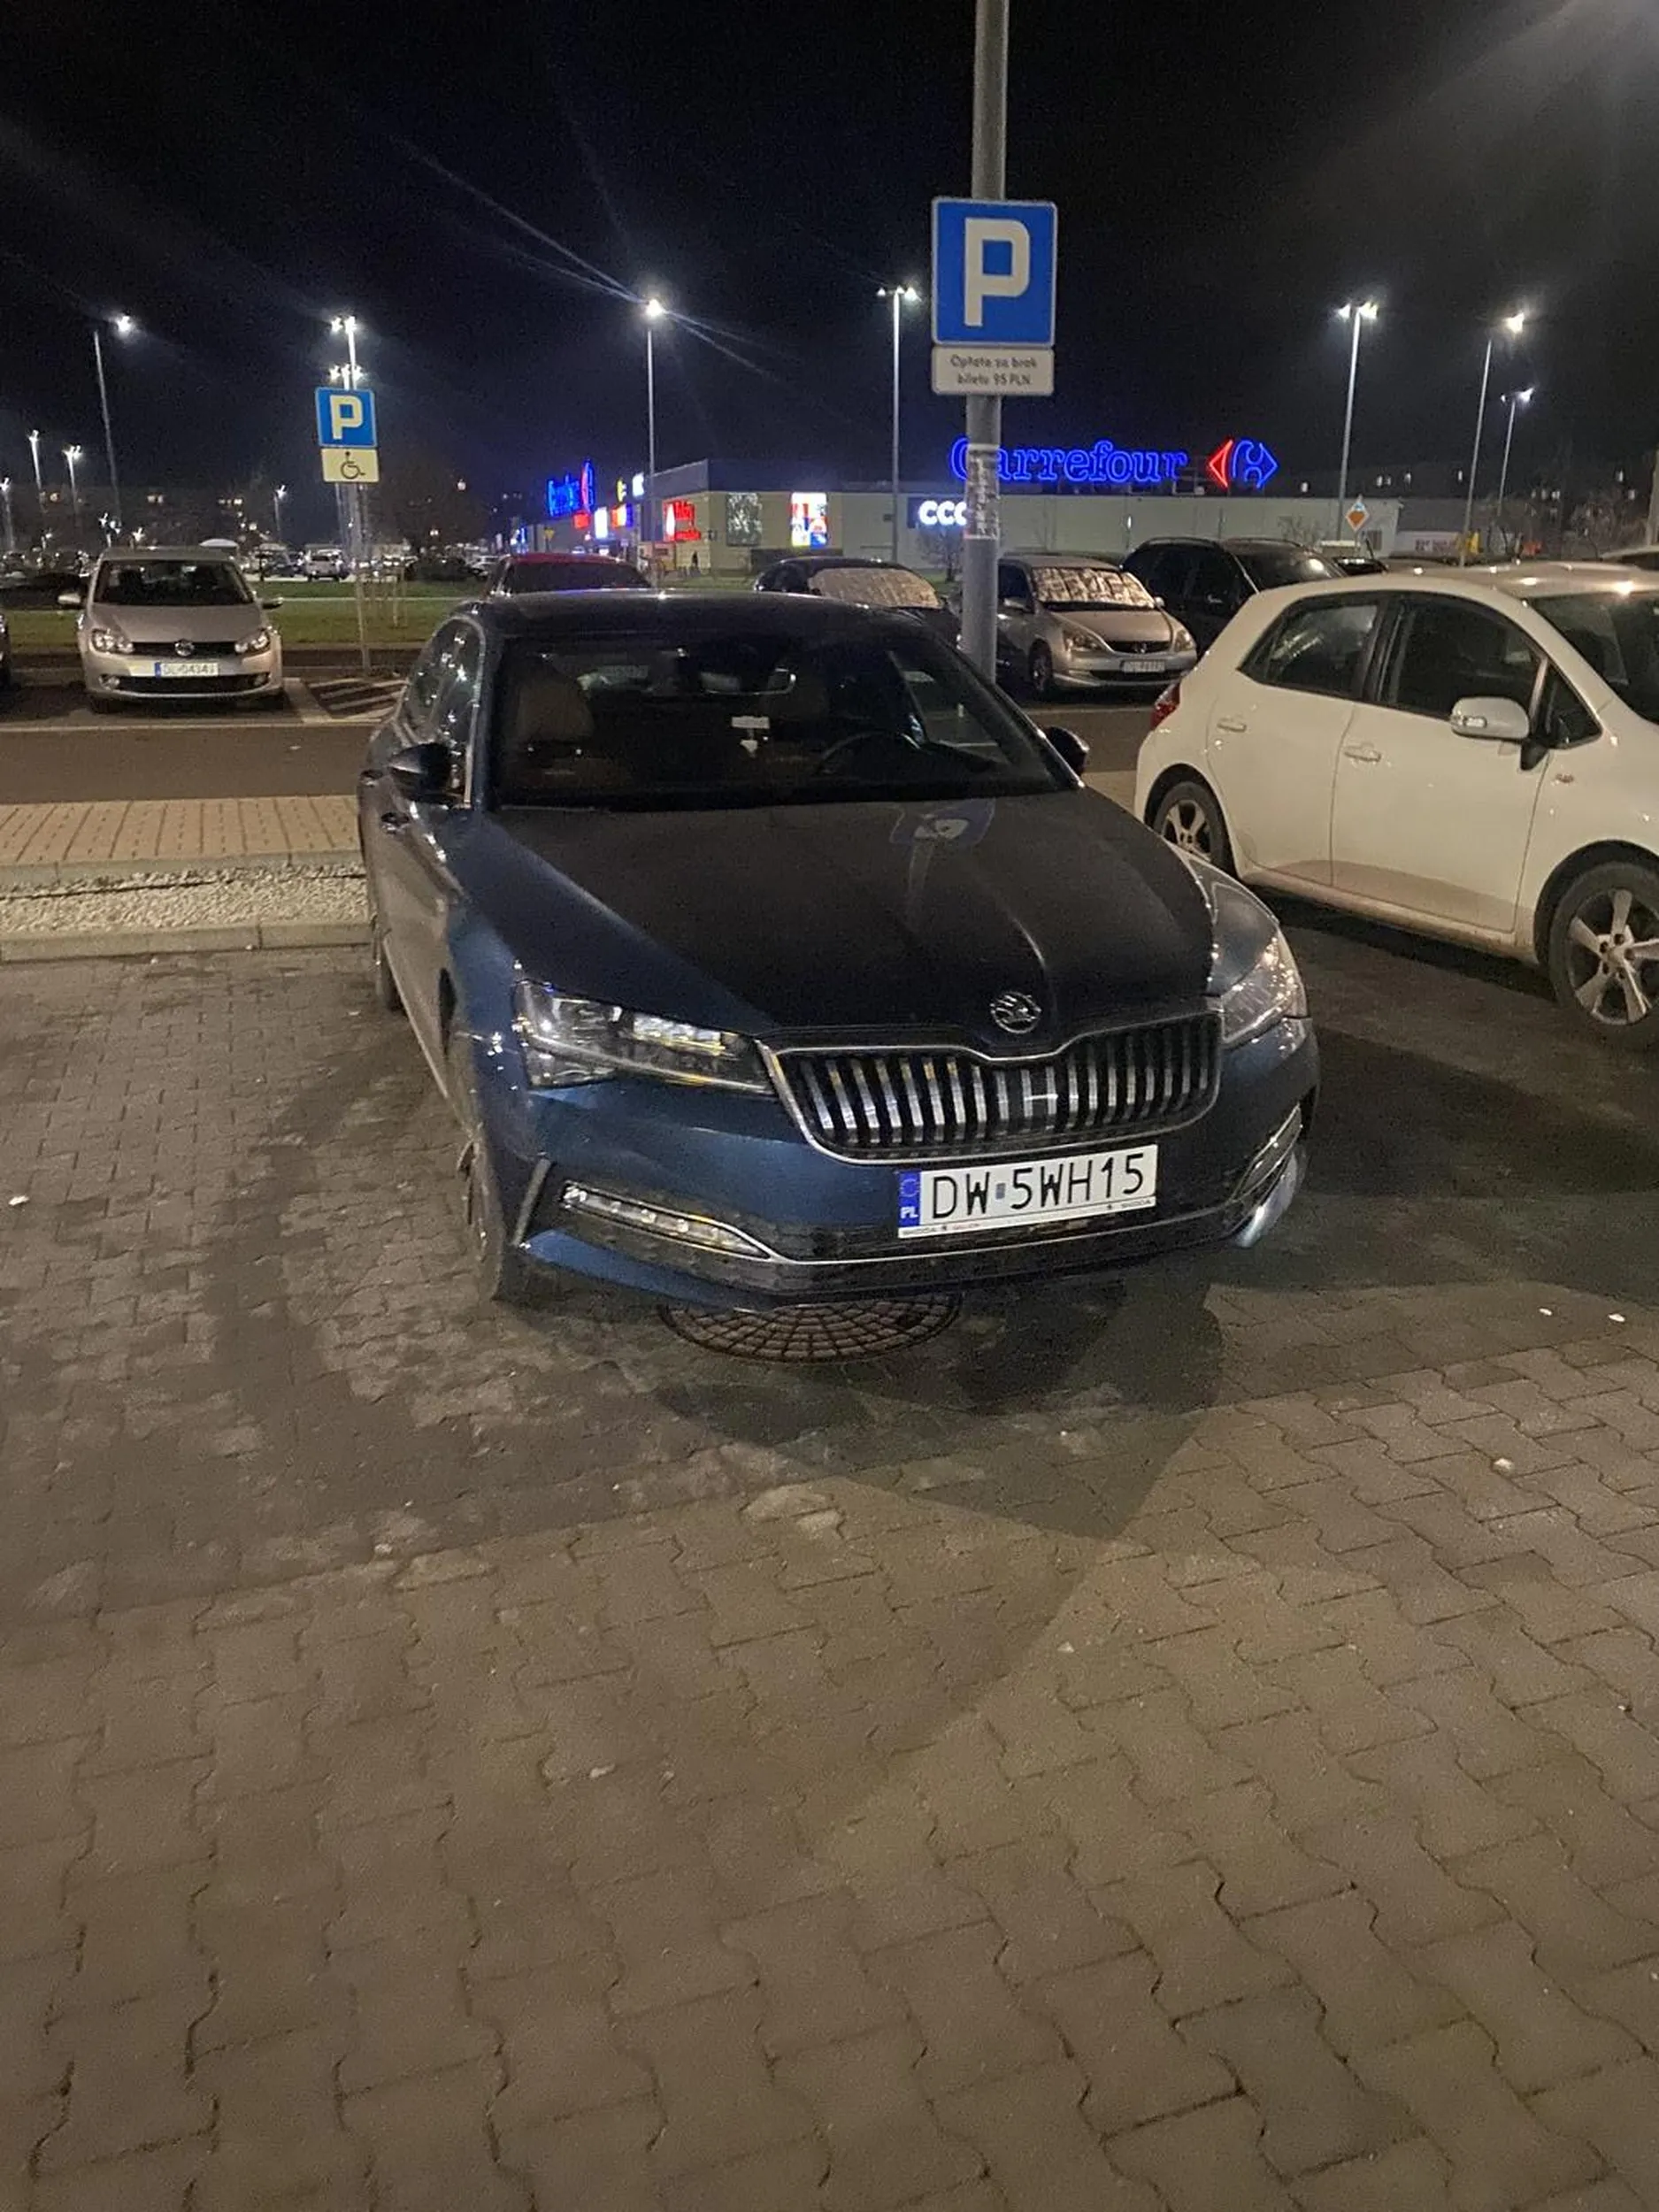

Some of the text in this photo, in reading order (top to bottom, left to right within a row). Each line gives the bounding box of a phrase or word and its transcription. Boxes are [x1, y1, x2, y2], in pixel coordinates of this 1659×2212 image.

[964, 217, 1031, 326] P
[1010, 372, 1031, 387] PLN
[329, 395, 363, 439] P
[932, 1152, 1145, 1219] DW 5WH15
[900, 1206, 918, 1219] PL
